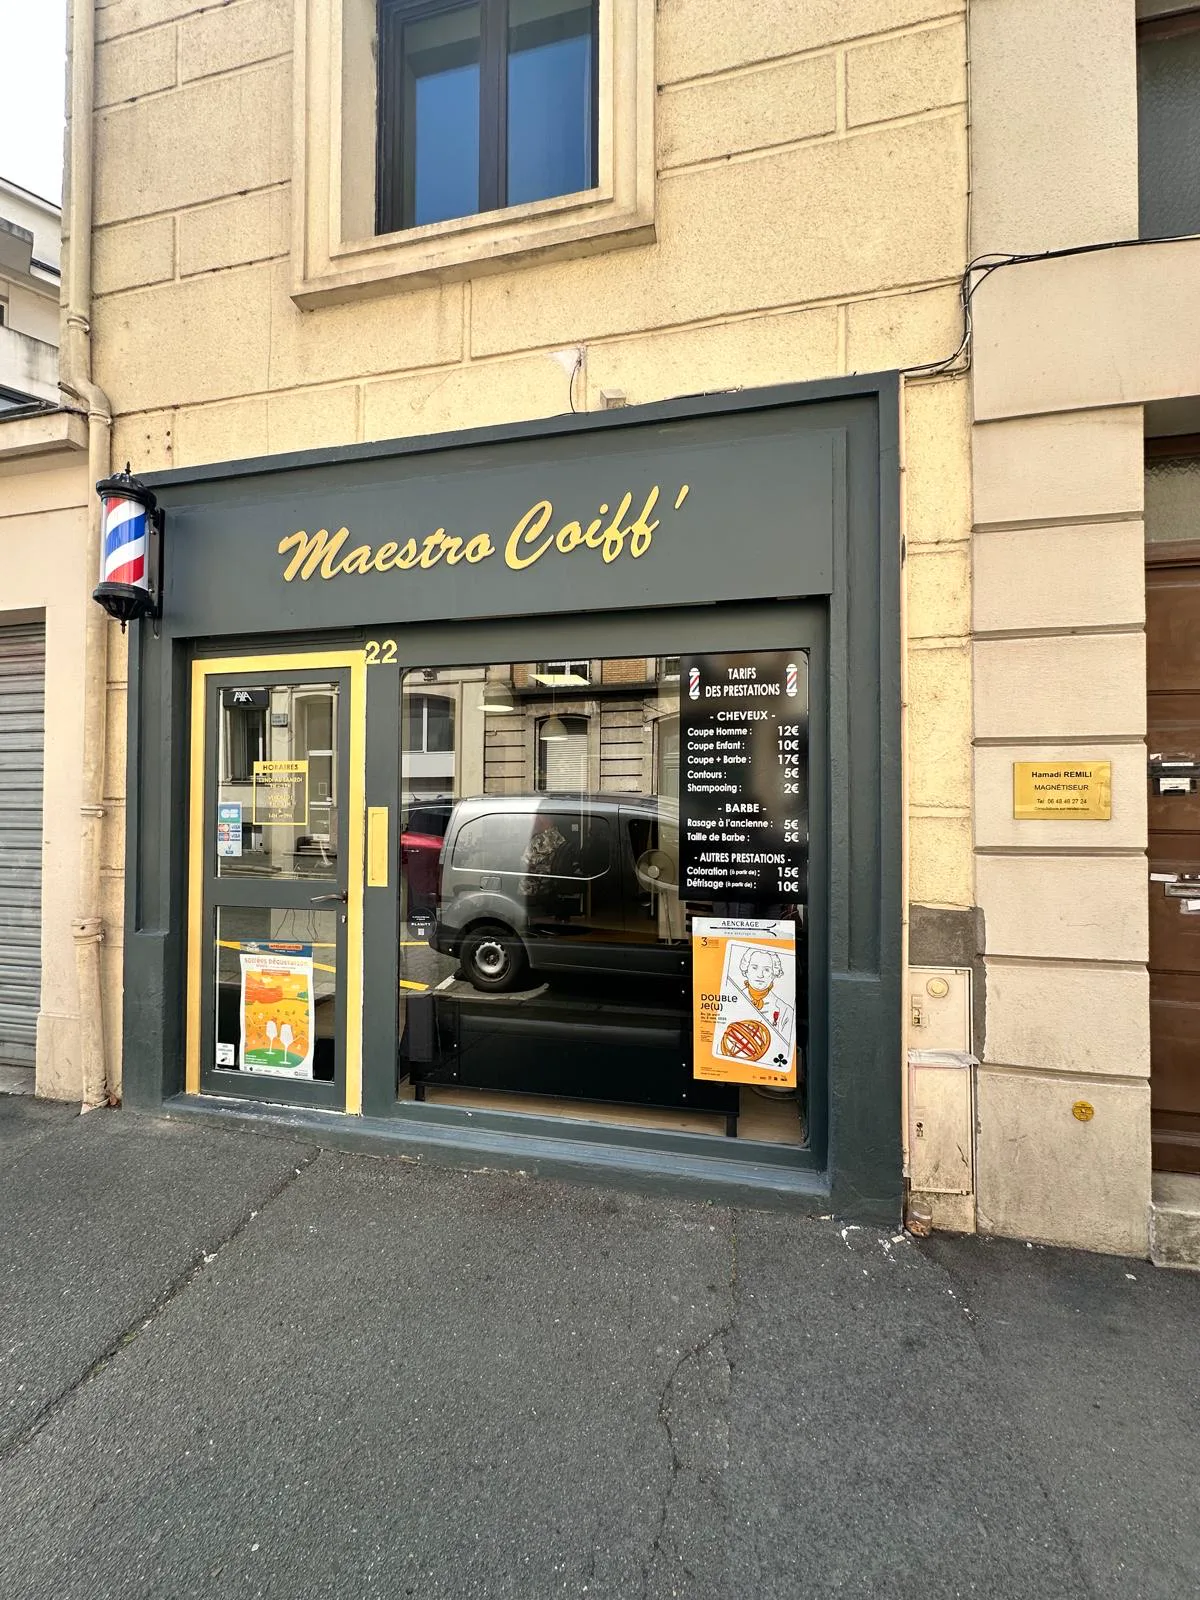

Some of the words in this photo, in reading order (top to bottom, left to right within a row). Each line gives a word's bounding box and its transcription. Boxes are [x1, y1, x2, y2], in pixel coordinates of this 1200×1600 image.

[278, 526, 496, 582] Maestro
[364, 639, 398, 664] 22
[727, 667, 757, 680] TARIFS
[705, 685, 721, 698] DES
[723, 683, 781, 697] PRESTATIONS
[717, 710, 768, 721] CHEVEUX
[687, 727, 715, 738] Coupe
[716, 727, 748, 736] Homme
[777, 725, 800, 737] 12€
[687, 741, 715, 752] Coupe
[716, 741, 741, 750] Enfant
[777, 740, 800, 751] 10€
[687, 755, 715, 766] Coupe
[723, 755, 747, 764] Barbe
[777, 754, 800, 765] 17€
[687, 770, 723, 779] Contours
[783, 768, 800, 779] 5€
[687, 783, 738, 794] Shampooing
[783, 783, 800, 794] 2€
[1034, 783, 1089, 791] MAGNÉTISEUR
[725, 804, 760, 813] BARBE
[687, 818, 717, 829] Rasage
[718, 818, 724, 828] à
[725, 818, 769, 828] l'ancienne
[783, 819, 799, 830] 5€
[687, 832, 708, 841] Taille
[709, 832, 720, 842] de
[721, 832, 746, 842] Barbe
[783, 831, 800, 843] 5€
[699, 852, 730, 863] AUTRES
[731, 853, 786, 864] PRESTATIONS
[686, 866, 728, 876] Coloration
[777, 867, 800, 878] 15€
[686, 878, 724, 890] Défrisage
[777, 881, 799, 892] 10€
[721, 920, 760, 928] AENCRAGE
[701, 936, 708, 947] 3
